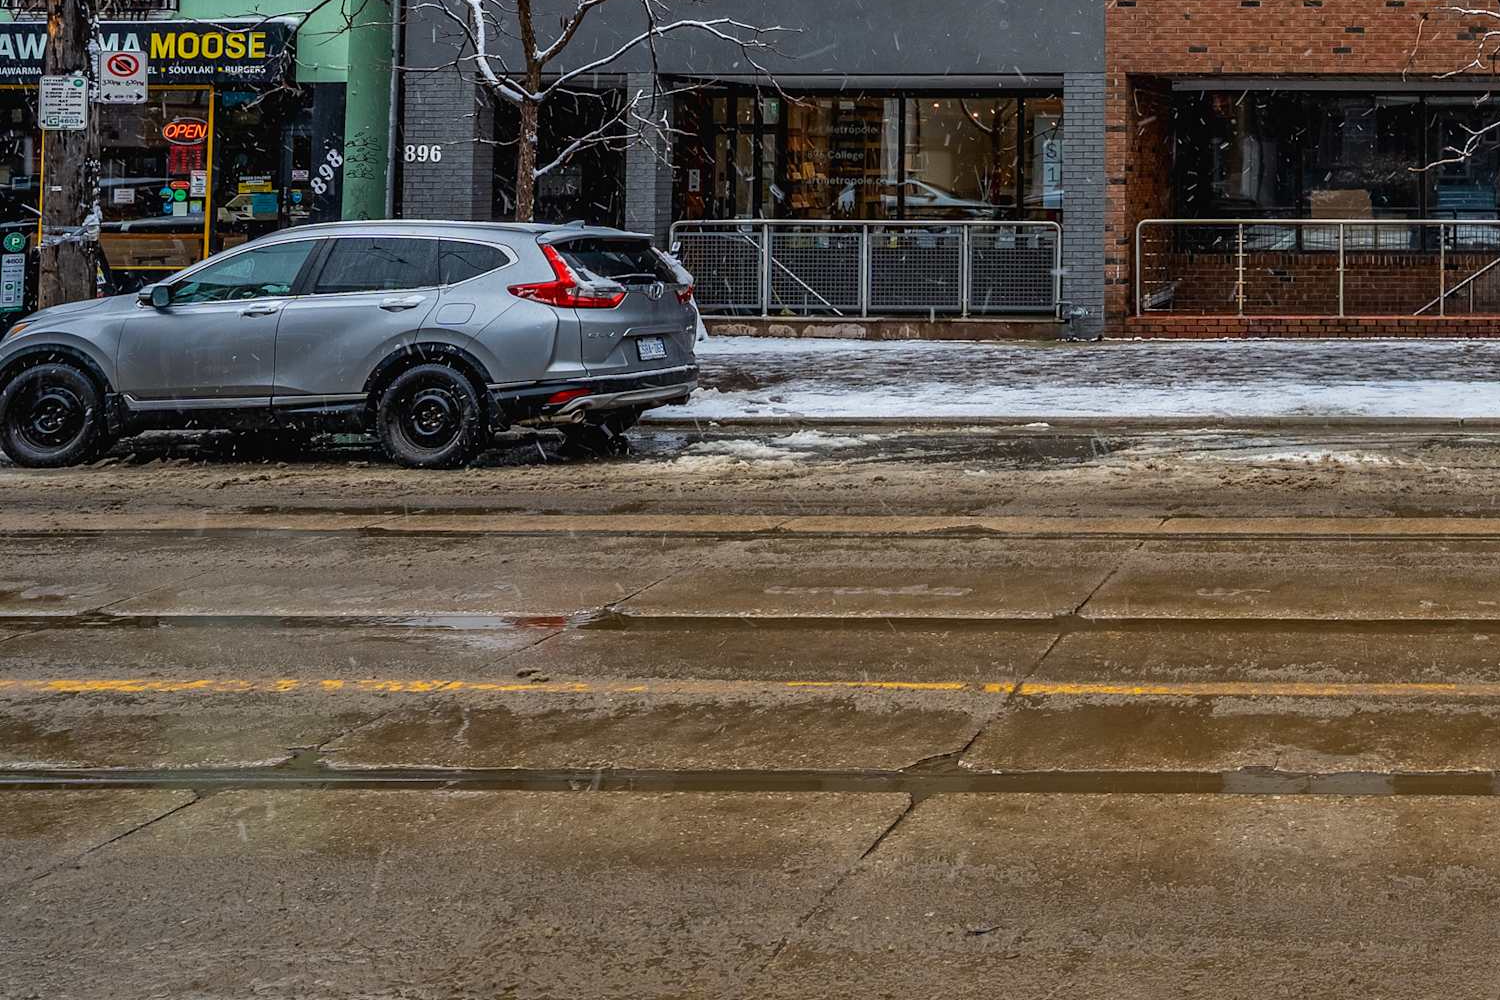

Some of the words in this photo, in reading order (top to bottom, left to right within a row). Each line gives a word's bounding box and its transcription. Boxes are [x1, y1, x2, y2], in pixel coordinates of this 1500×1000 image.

[150, 32, 266, 59] MOOSE
[168, 65, 214, 75] SOUVLAKI
[225, 65, 266, 74] BURGERS
[165, 124, 207, 138] OPEN
[404, 144, 442, 163] 896
[827, 150, 864, 161] College
[310, 149, 344, 195] 898
